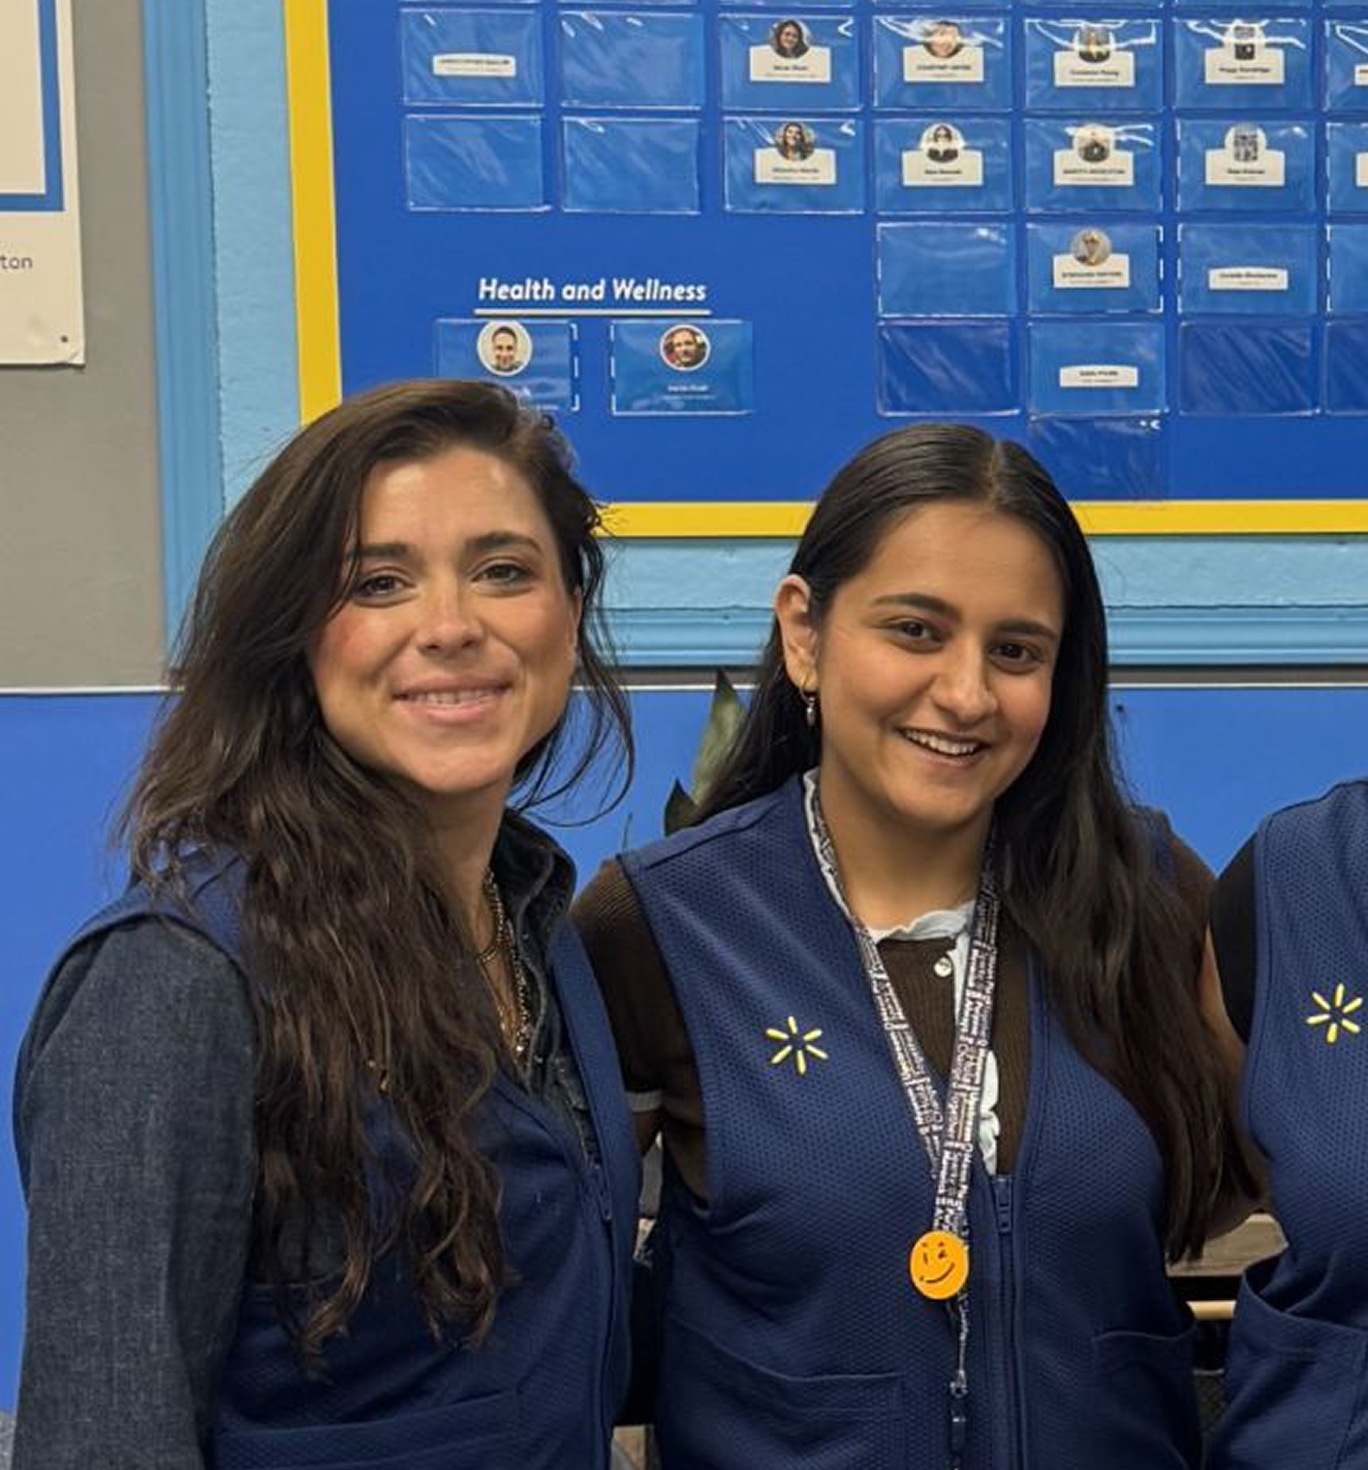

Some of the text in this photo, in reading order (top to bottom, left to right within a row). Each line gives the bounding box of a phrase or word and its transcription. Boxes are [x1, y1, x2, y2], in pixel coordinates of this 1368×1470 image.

[0, 255, 33, 270] ton
[479, 278, 707, 301] Health and Wellness
